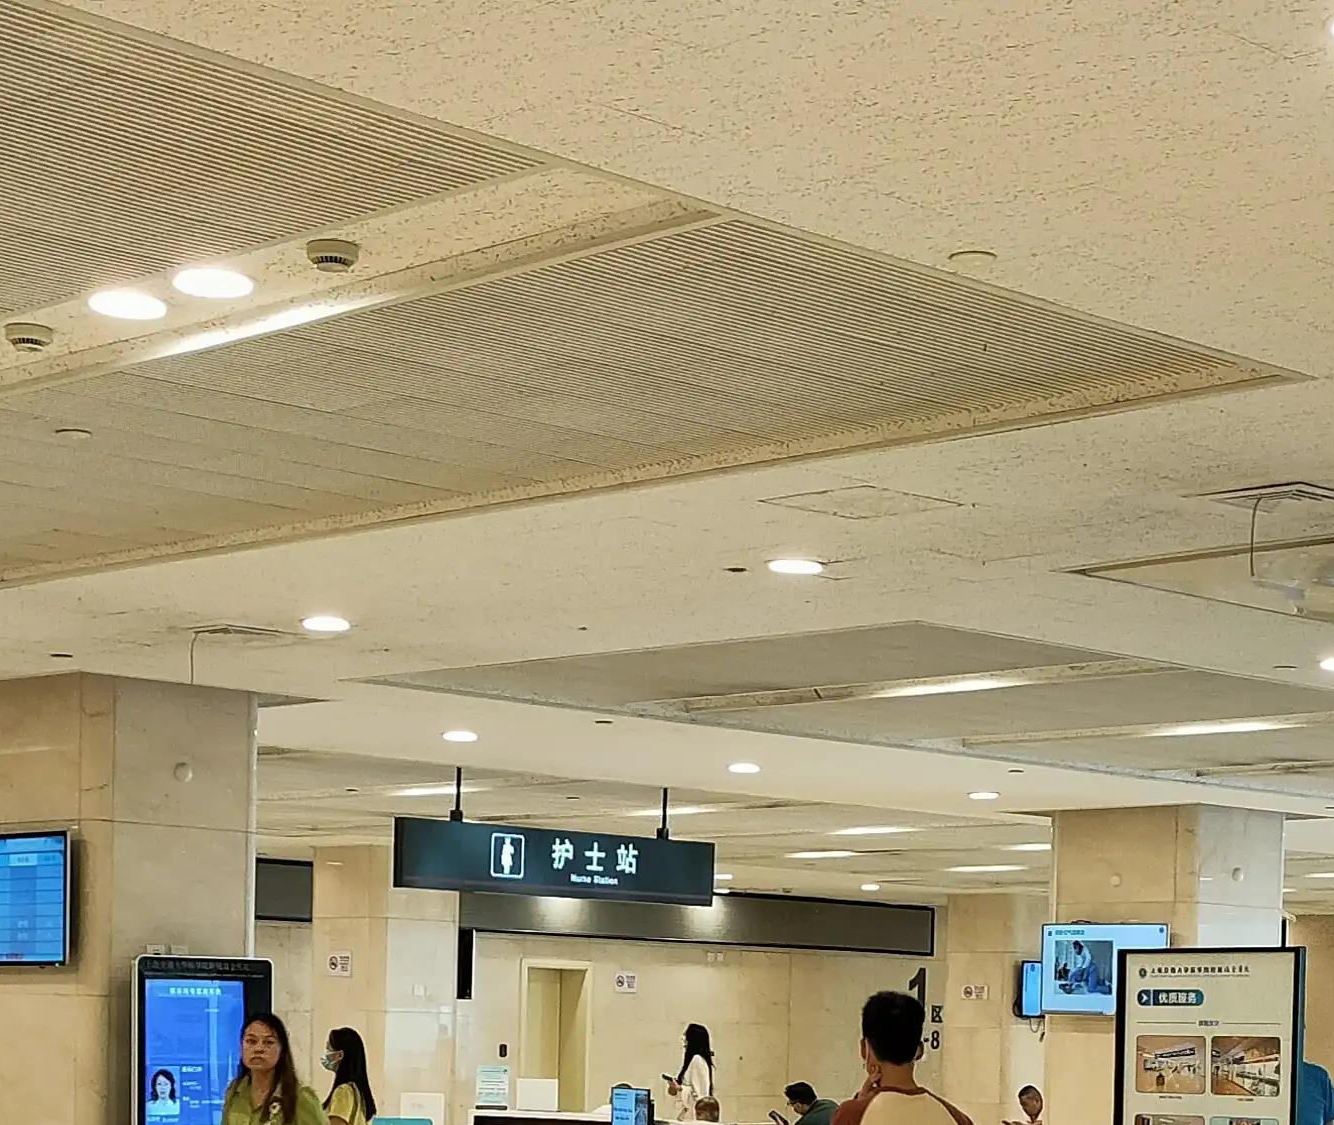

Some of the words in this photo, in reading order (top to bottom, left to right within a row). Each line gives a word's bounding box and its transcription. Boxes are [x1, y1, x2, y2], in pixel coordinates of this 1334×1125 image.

[551, 837, 639, 874] 护士站
[570, 873, 592, 884] Nurse
[593, 875, 619, 886] Station
